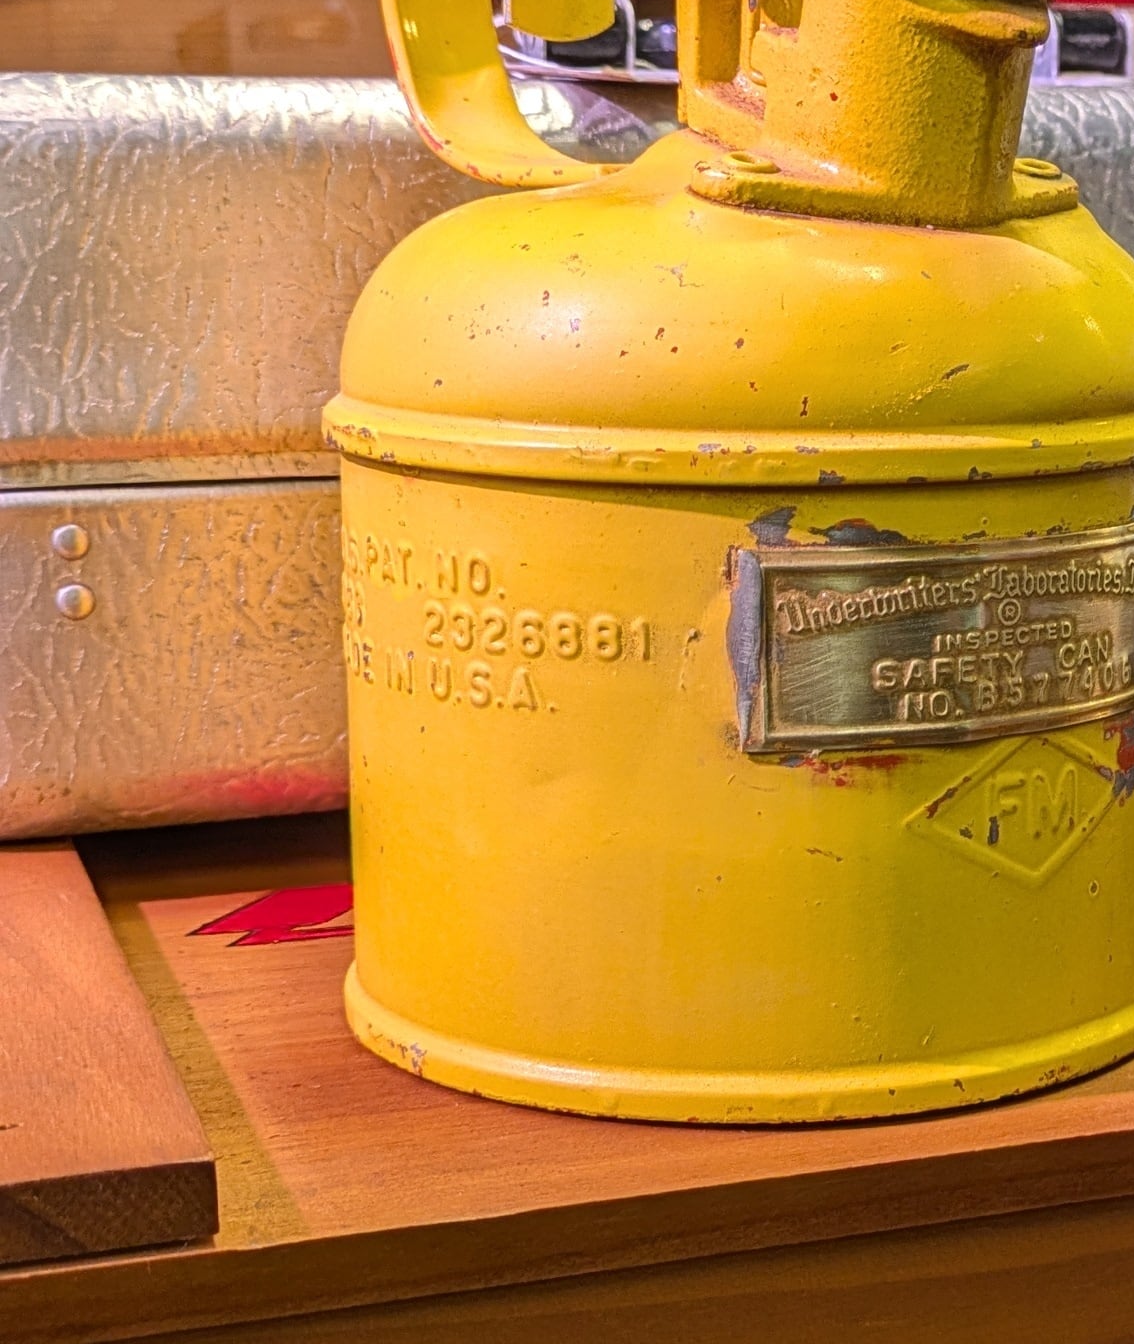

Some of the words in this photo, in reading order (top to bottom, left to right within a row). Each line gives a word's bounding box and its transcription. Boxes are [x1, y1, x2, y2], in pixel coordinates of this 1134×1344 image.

[873, 650, 1025, 693] SAFETY
[1056, 634, 1112, 670] CAN
[932, 621, 1073, 654] INSPECTED
[385, 647, 414, 696] IN
[429, 653, 558, 714] U.S.A.
[901, 689, 966, 722] NO.
[985, 763, 1079, 847] FM
